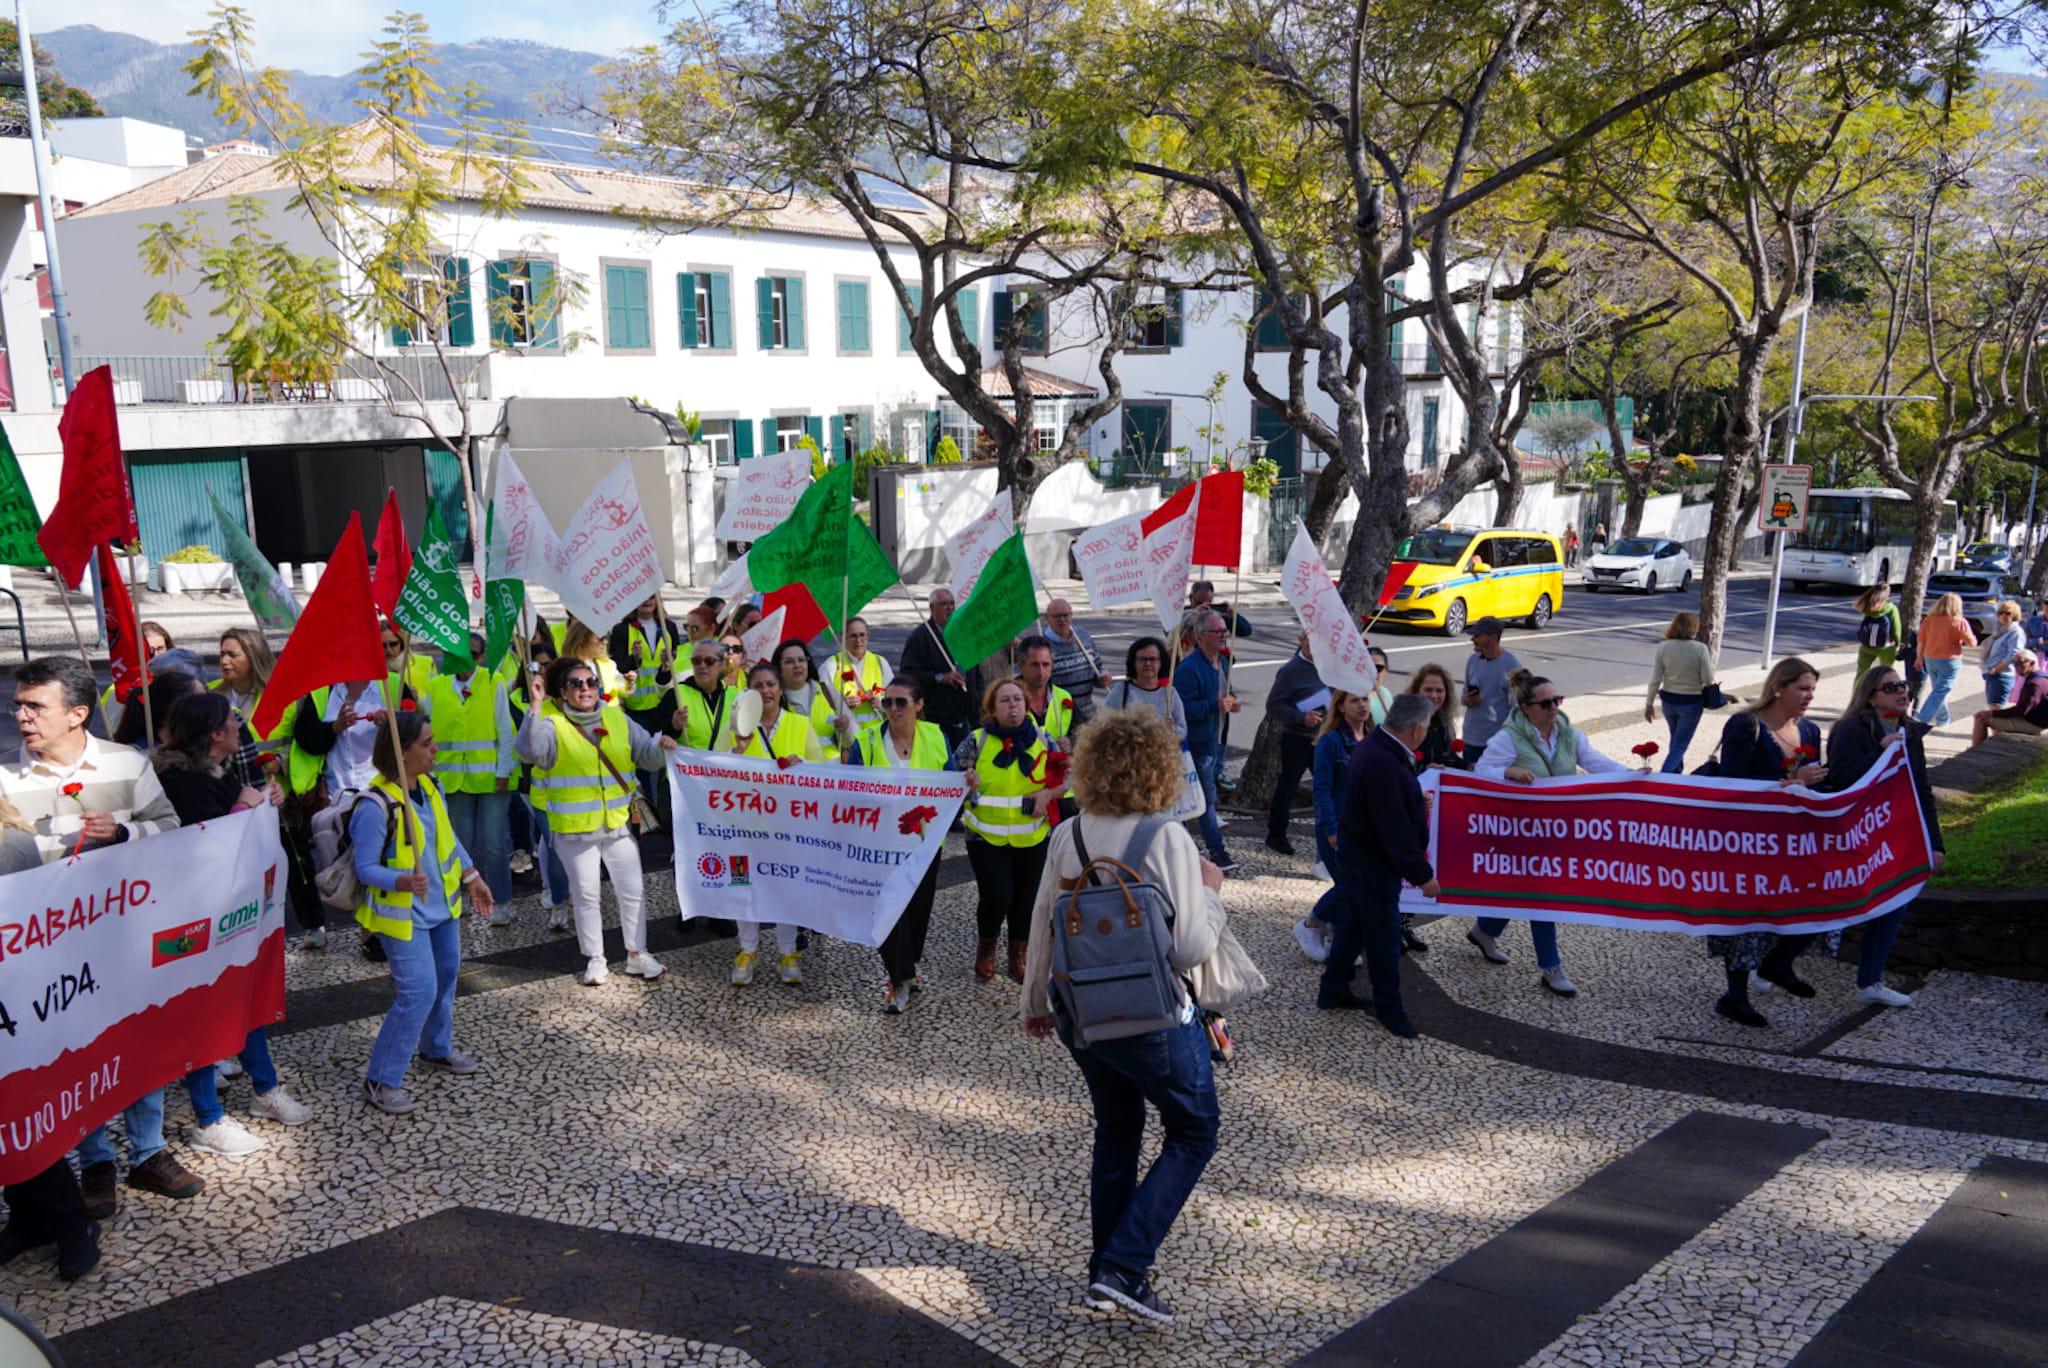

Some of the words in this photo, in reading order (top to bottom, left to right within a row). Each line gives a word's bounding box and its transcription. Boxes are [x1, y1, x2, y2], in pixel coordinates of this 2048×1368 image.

[409, 566, 438, 601] nião
[440, 600, 469, 630] dos
[675, 763, 750, 782] TRABALHADORAS
[752, 772, 764, 784] DA
[767, 773, 795, 786] SANTA
[798, 776, 820, 789] CASA
[823, 778, 834, 789] DA
[838, 779, 901, 796] MISERICÓRDIA
[904, 786, 918, 797] DE
[919, 787, 963, 798] MACHICO
[708, 788, 777, 815] ESTÃO
[790, 800, 818, 820] EM
[832, 803, 881, 832] LUTA
[1468, 813, 1568, 838] SINDICATO
[1574, 818, 1613, 841] DOS
[1618, 820, 1779, 855] TRABALHADORES
[1787, 832, 1817, 856] EM
[1823, 801, 1892, 851] FUNÇÕES
[696, 822, 769, 840] Exigimos
[774, 832, 791, 842] os
[795, 835, 841, 851] nossos
[757, 862, 800, 879] CESP
[1472, 847, 1562, 878] PÚBLICAS
[1568, 857, 1578, 878] E
[1583, 858, 1652, 887] SOCIAIS
[1657, 866, 1686, 890] DO
[1691, 871, 1729, 893] SUL
[1736, 873, 1747, 895] E
[1755, 874, 1800, 896] R.A.
[0, 879, 156, 962] RABALHO.
[0, 1102, 55, 1155] TURO
[61, 1081, 83, 1120] DE
[90, 1055, 121, 1102] PAZ
